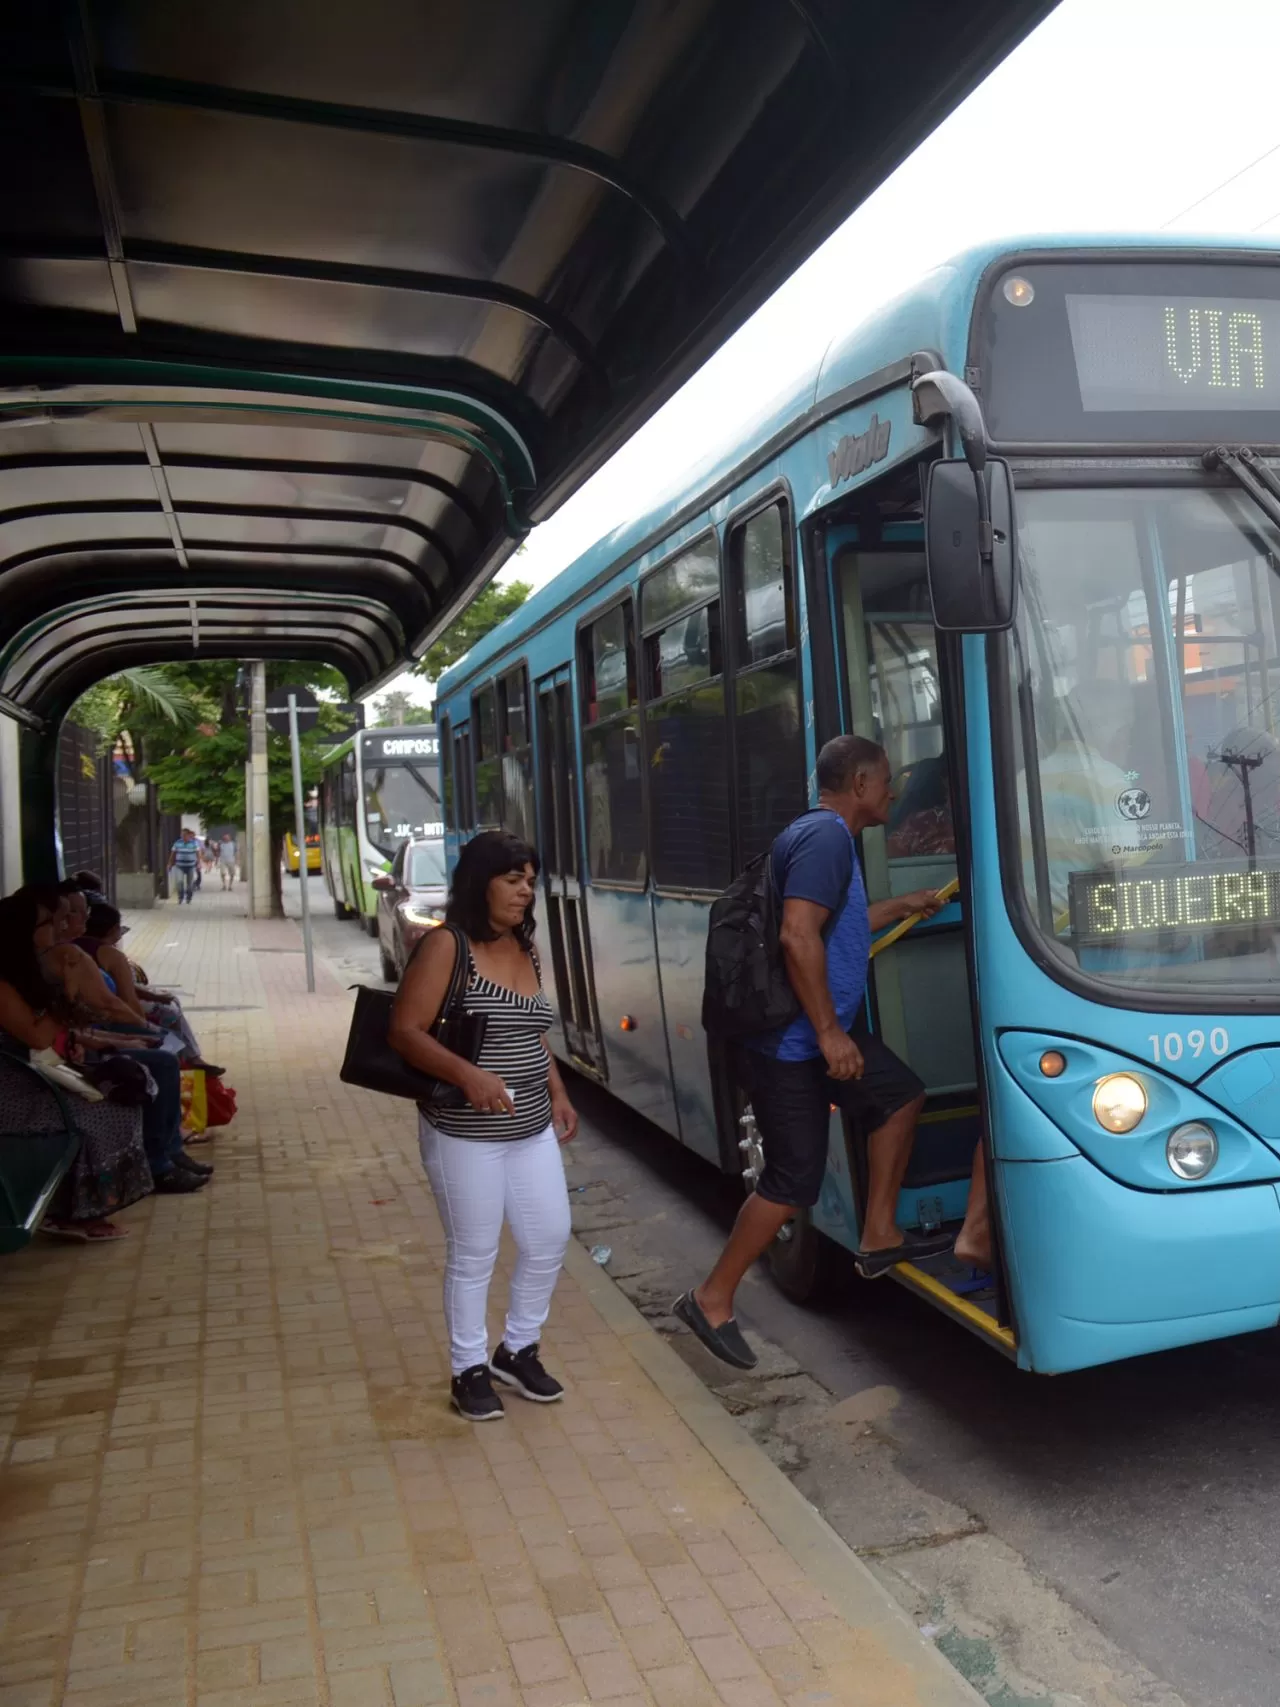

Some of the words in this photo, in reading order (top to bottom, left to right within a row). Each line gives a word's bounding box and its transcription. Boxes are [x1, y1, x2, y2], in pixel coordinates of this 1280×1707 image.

[1165, 307, 1264, 388] VIA
[383, 739, 431, 755] CAMPOS
[1123, 843, 1164, 853] Marcopolo
[1094, 871, 1269, 932] SIQUEIRA
[1148, 1027, 1229, 1063] 1090
